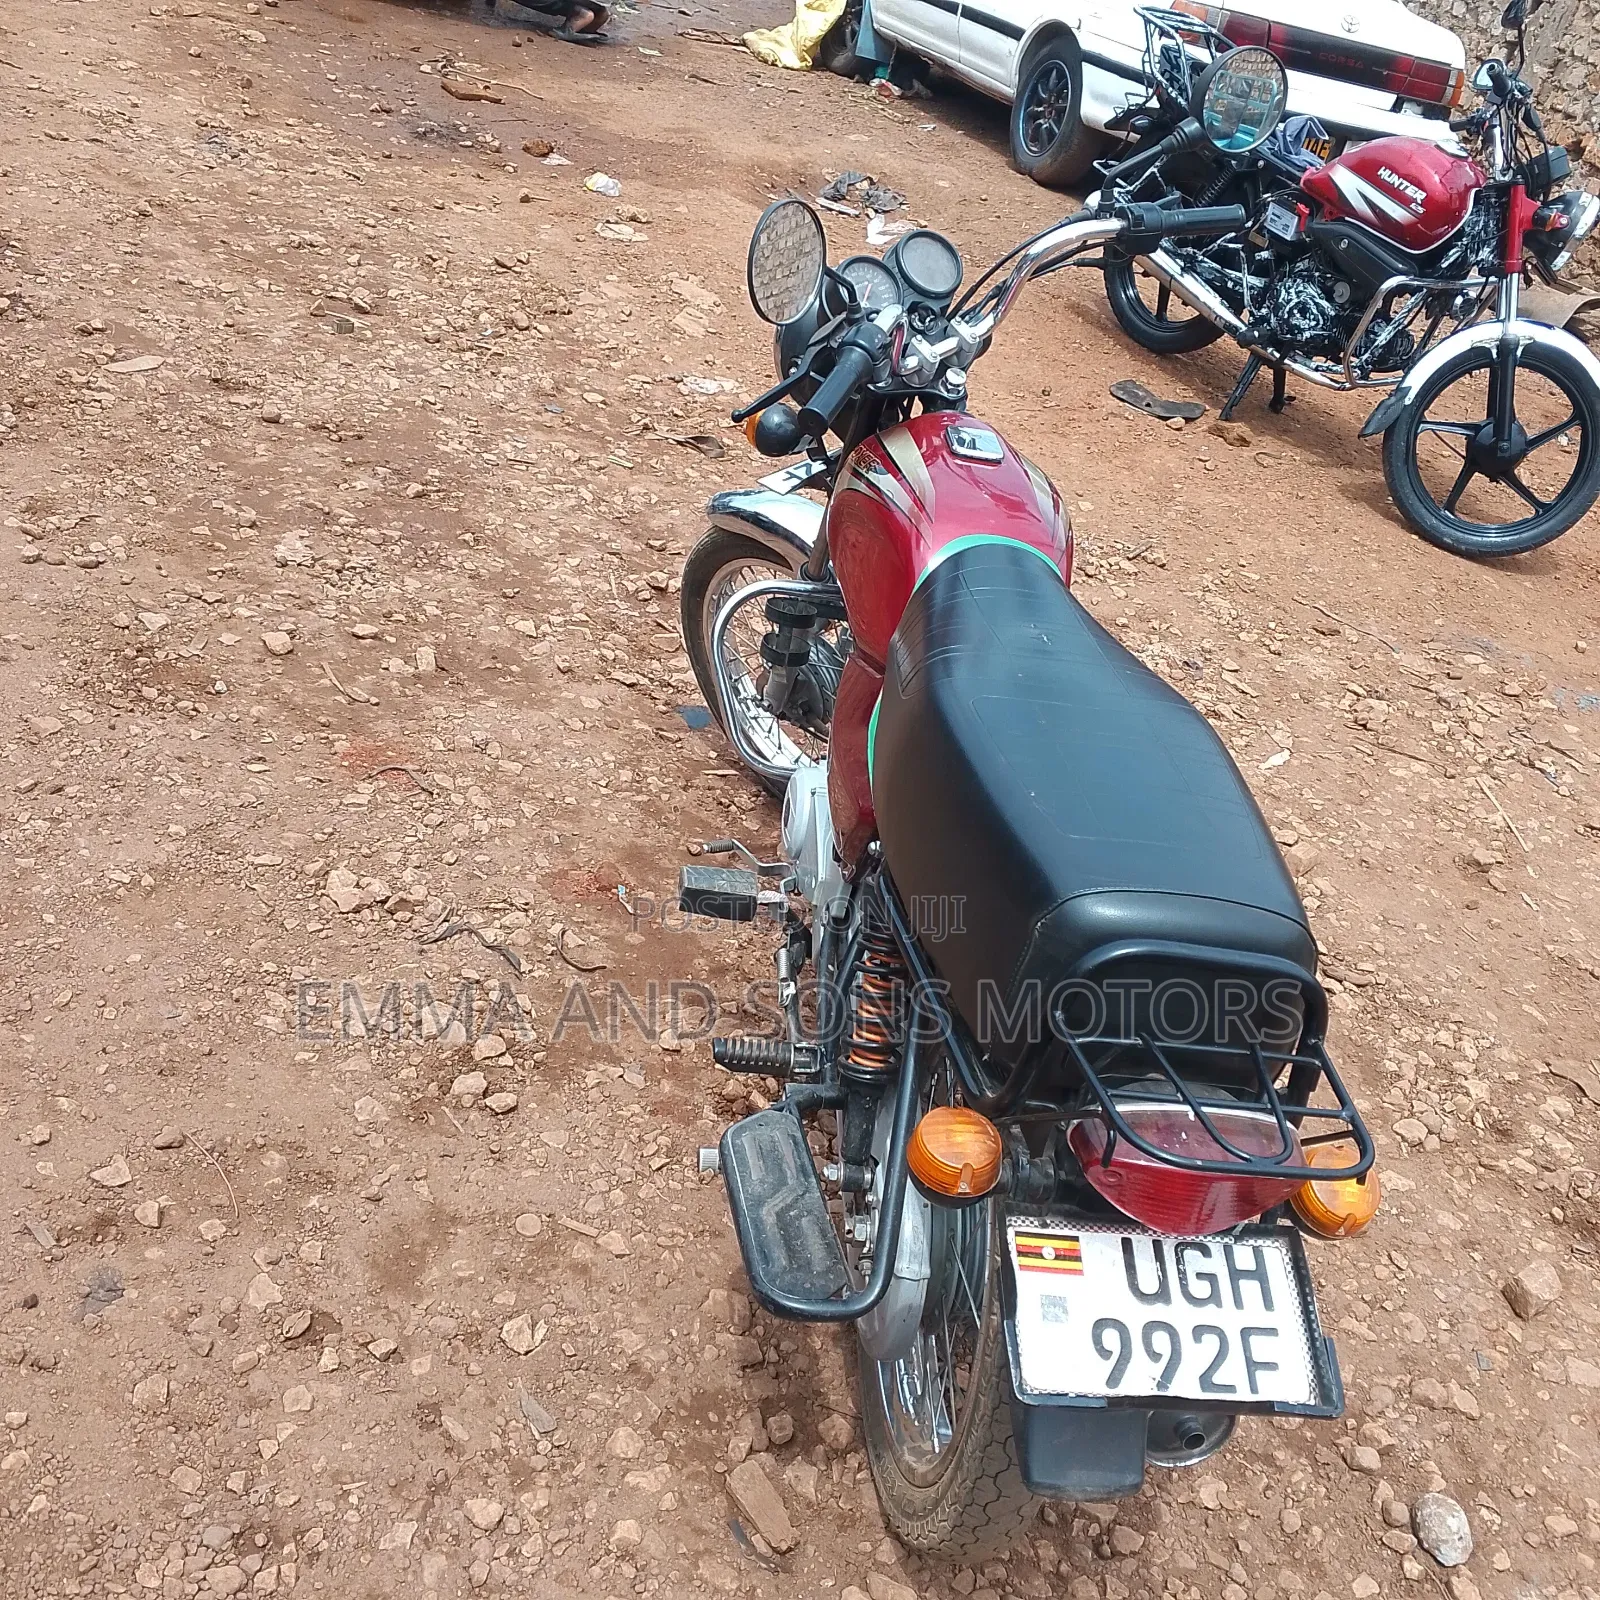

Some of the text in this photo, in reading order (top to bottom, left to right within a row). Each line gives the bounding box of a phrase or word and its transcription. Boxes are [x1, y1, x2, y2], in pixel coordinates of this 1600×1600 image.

[1318, 52, 1364, 69] CORSA
[1377, 166, 1428, 204] HUNTER
[852, 444, 883, 474] OXER
[1121, 1236, 1275, 1312] UGH
[1091, 1317, 1279, 1395] 992F
